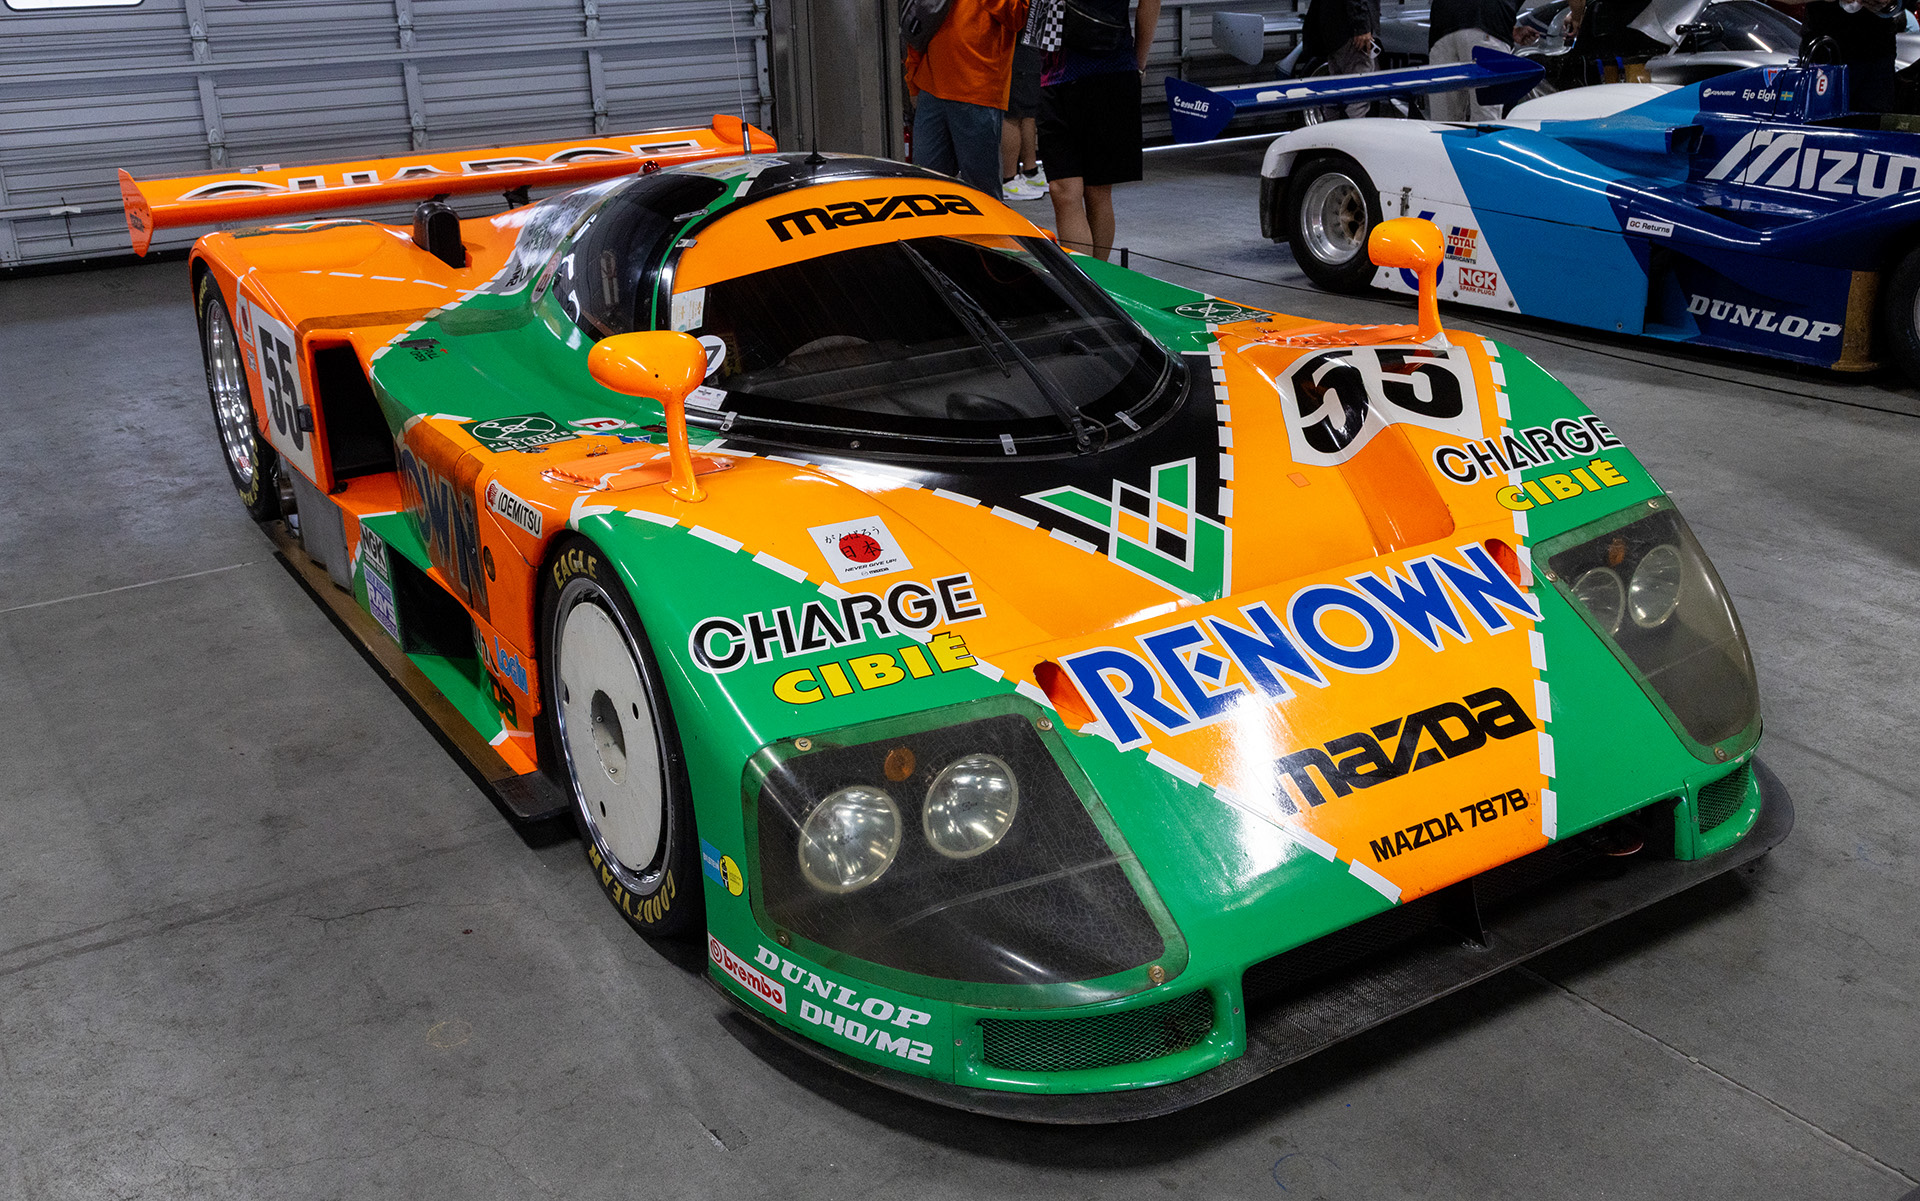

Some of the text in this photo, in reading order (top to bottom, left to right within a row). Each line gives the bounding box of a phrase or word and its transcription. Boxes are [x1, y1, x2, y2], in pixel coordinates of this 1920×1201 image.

[1742, 89, 1776, 102] Eje Elgh
[1818, 79, 1825, 92] E
[1447, 235, 1477, 250] TOTAL
[1629, 220, 1671, 234] GC Returns
[1445, 255, 1477, 265] LUBRICANTS
[1460, 268, 1496, 290] NGK
[1459, 285, 1496, 297] SPARK PLUGS
[1686, 294, 1842, 342] DUNLOP
[259, 325, 304, 452] 55
[1291, 349, 1463, 454] 55
[1432, 414, 1625, 486] CHARGE
[497, 490, 542, 537] IDEMITSU
[825, 526, 880, 544] がんばろう
[553, 548, 598, 591] EAGLE
[840, 540, 884, 558] 日本
[844, 557, 897, 573] NEVER GIVE UP!
[689, 572, 987, 674] CHARGE
[1057, 541, 1544, 752] RENOWN
[773, 631, 979, 705] CIBIÉ
[1368, 788, 1529, 863] MAZDA 787B
[722, 948, 783, 1005] brembo
[753, 944, 932, 1029] DUNLOP
[799, 999, 934, 1065] D40/M2
